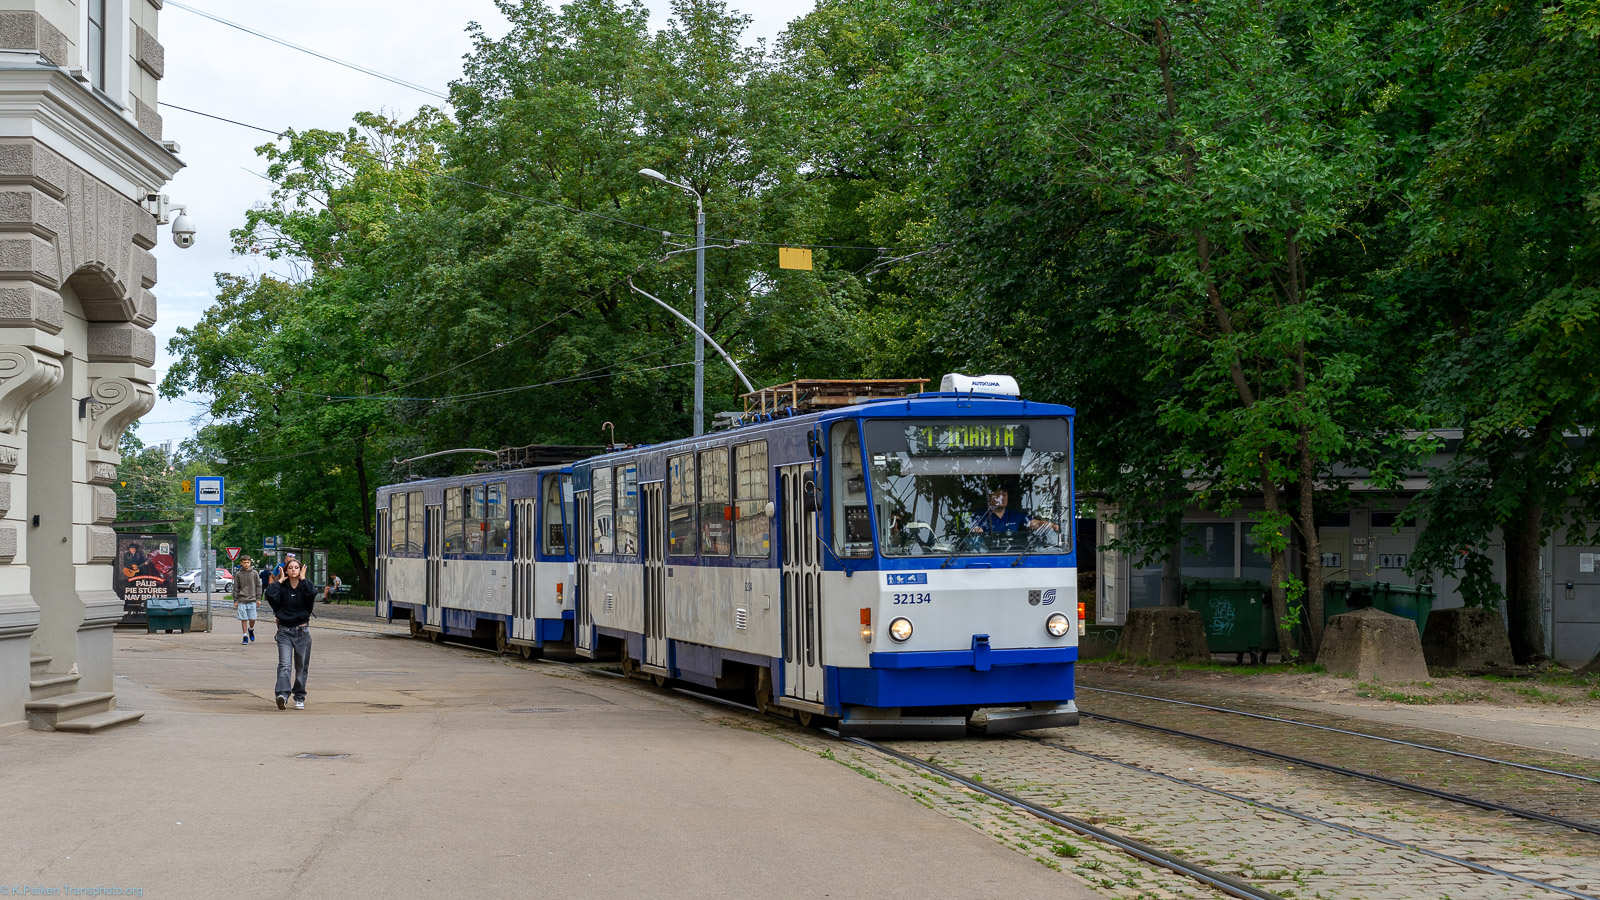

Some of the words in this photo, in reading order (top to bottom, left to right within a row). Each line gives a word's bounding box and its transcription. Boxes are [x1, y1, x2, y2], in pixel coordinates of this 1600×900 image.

[922, 426, 932, 446] 1
[948, 425, 1014, 446] IMANTA
[136, 579, 157, 587] PĀLIS
[138, 586, 167, 594] STŪRES
[893, 593, 932, 605] 32134
